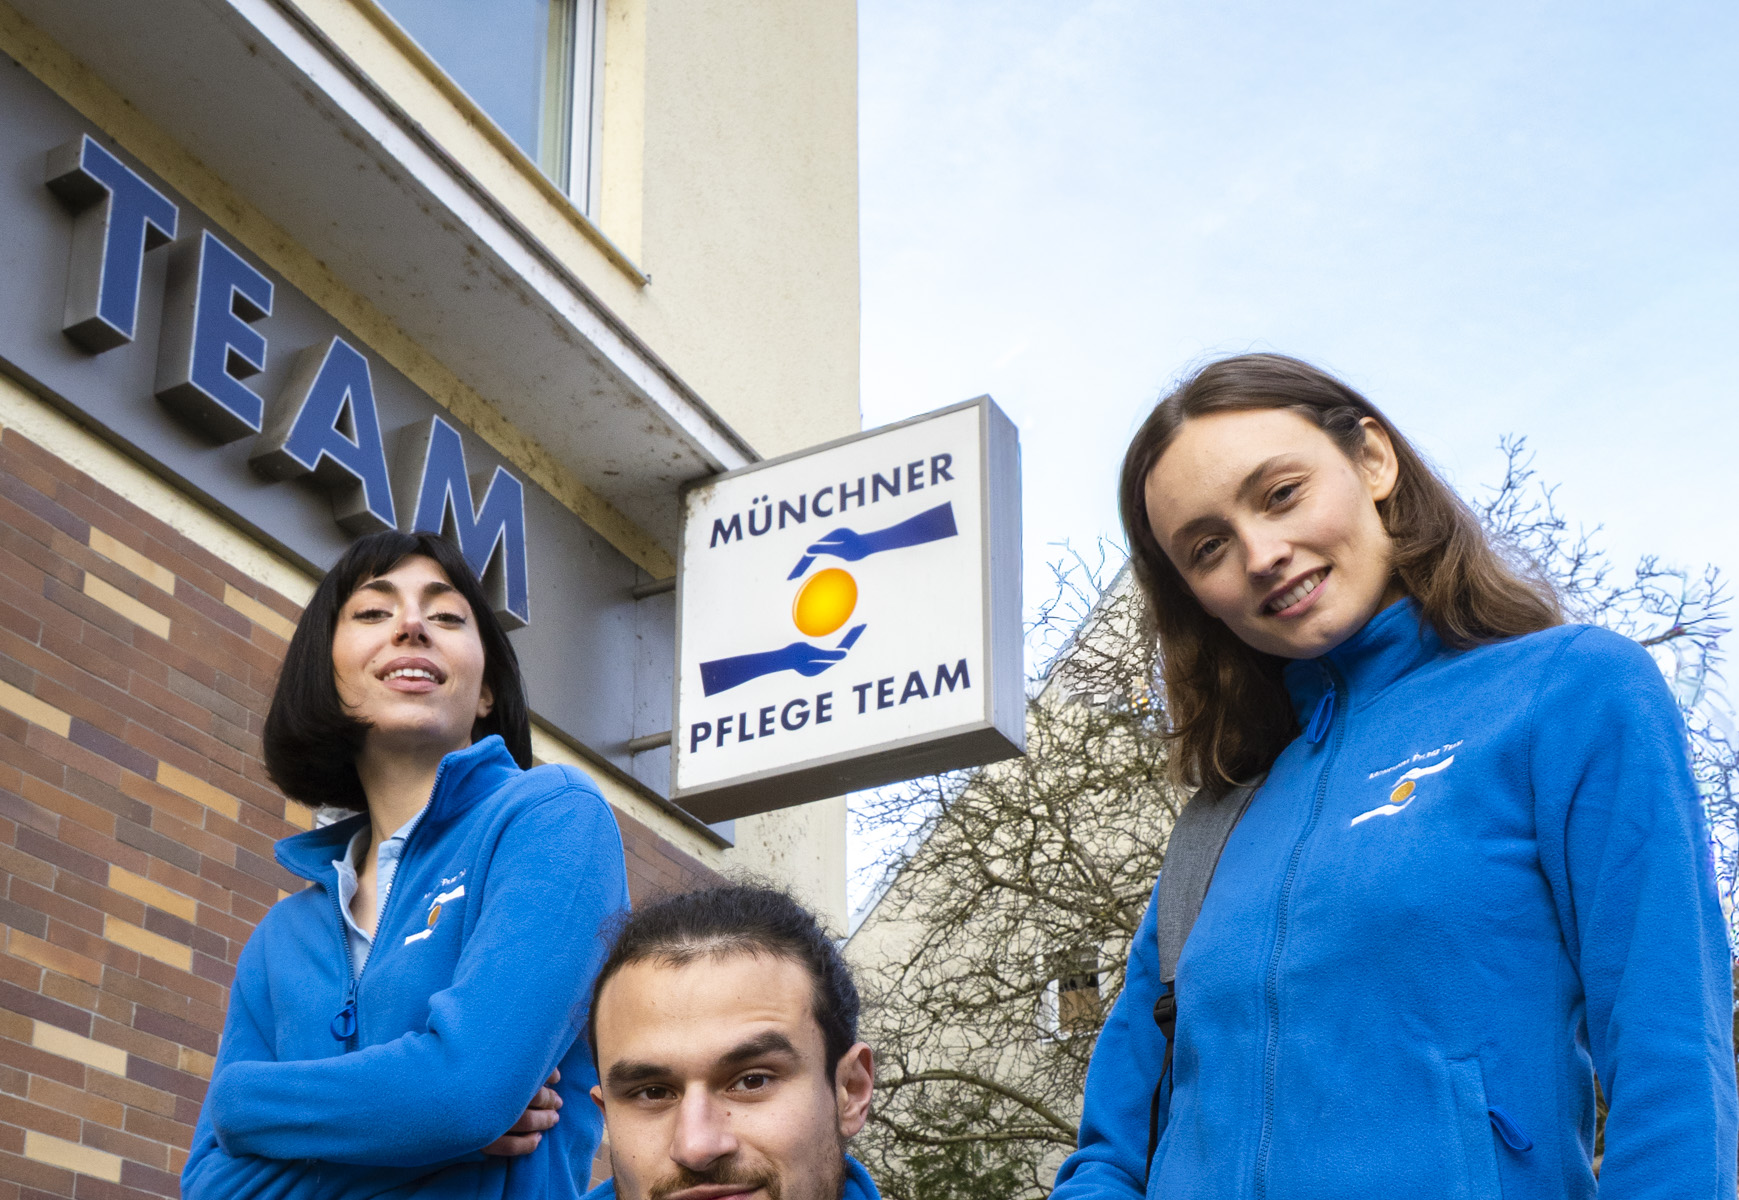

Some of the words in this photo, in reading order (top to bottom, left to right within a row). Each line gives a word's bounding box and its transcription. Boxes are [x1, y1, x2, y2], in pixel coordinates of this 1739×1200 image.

[79, 133, 530, 626] TEAM
[709, 453, 955, 549] MÜNCHNER
[690, 691, 833, 753] PFLEGE
[853, 658, 971, 715] TEAM
